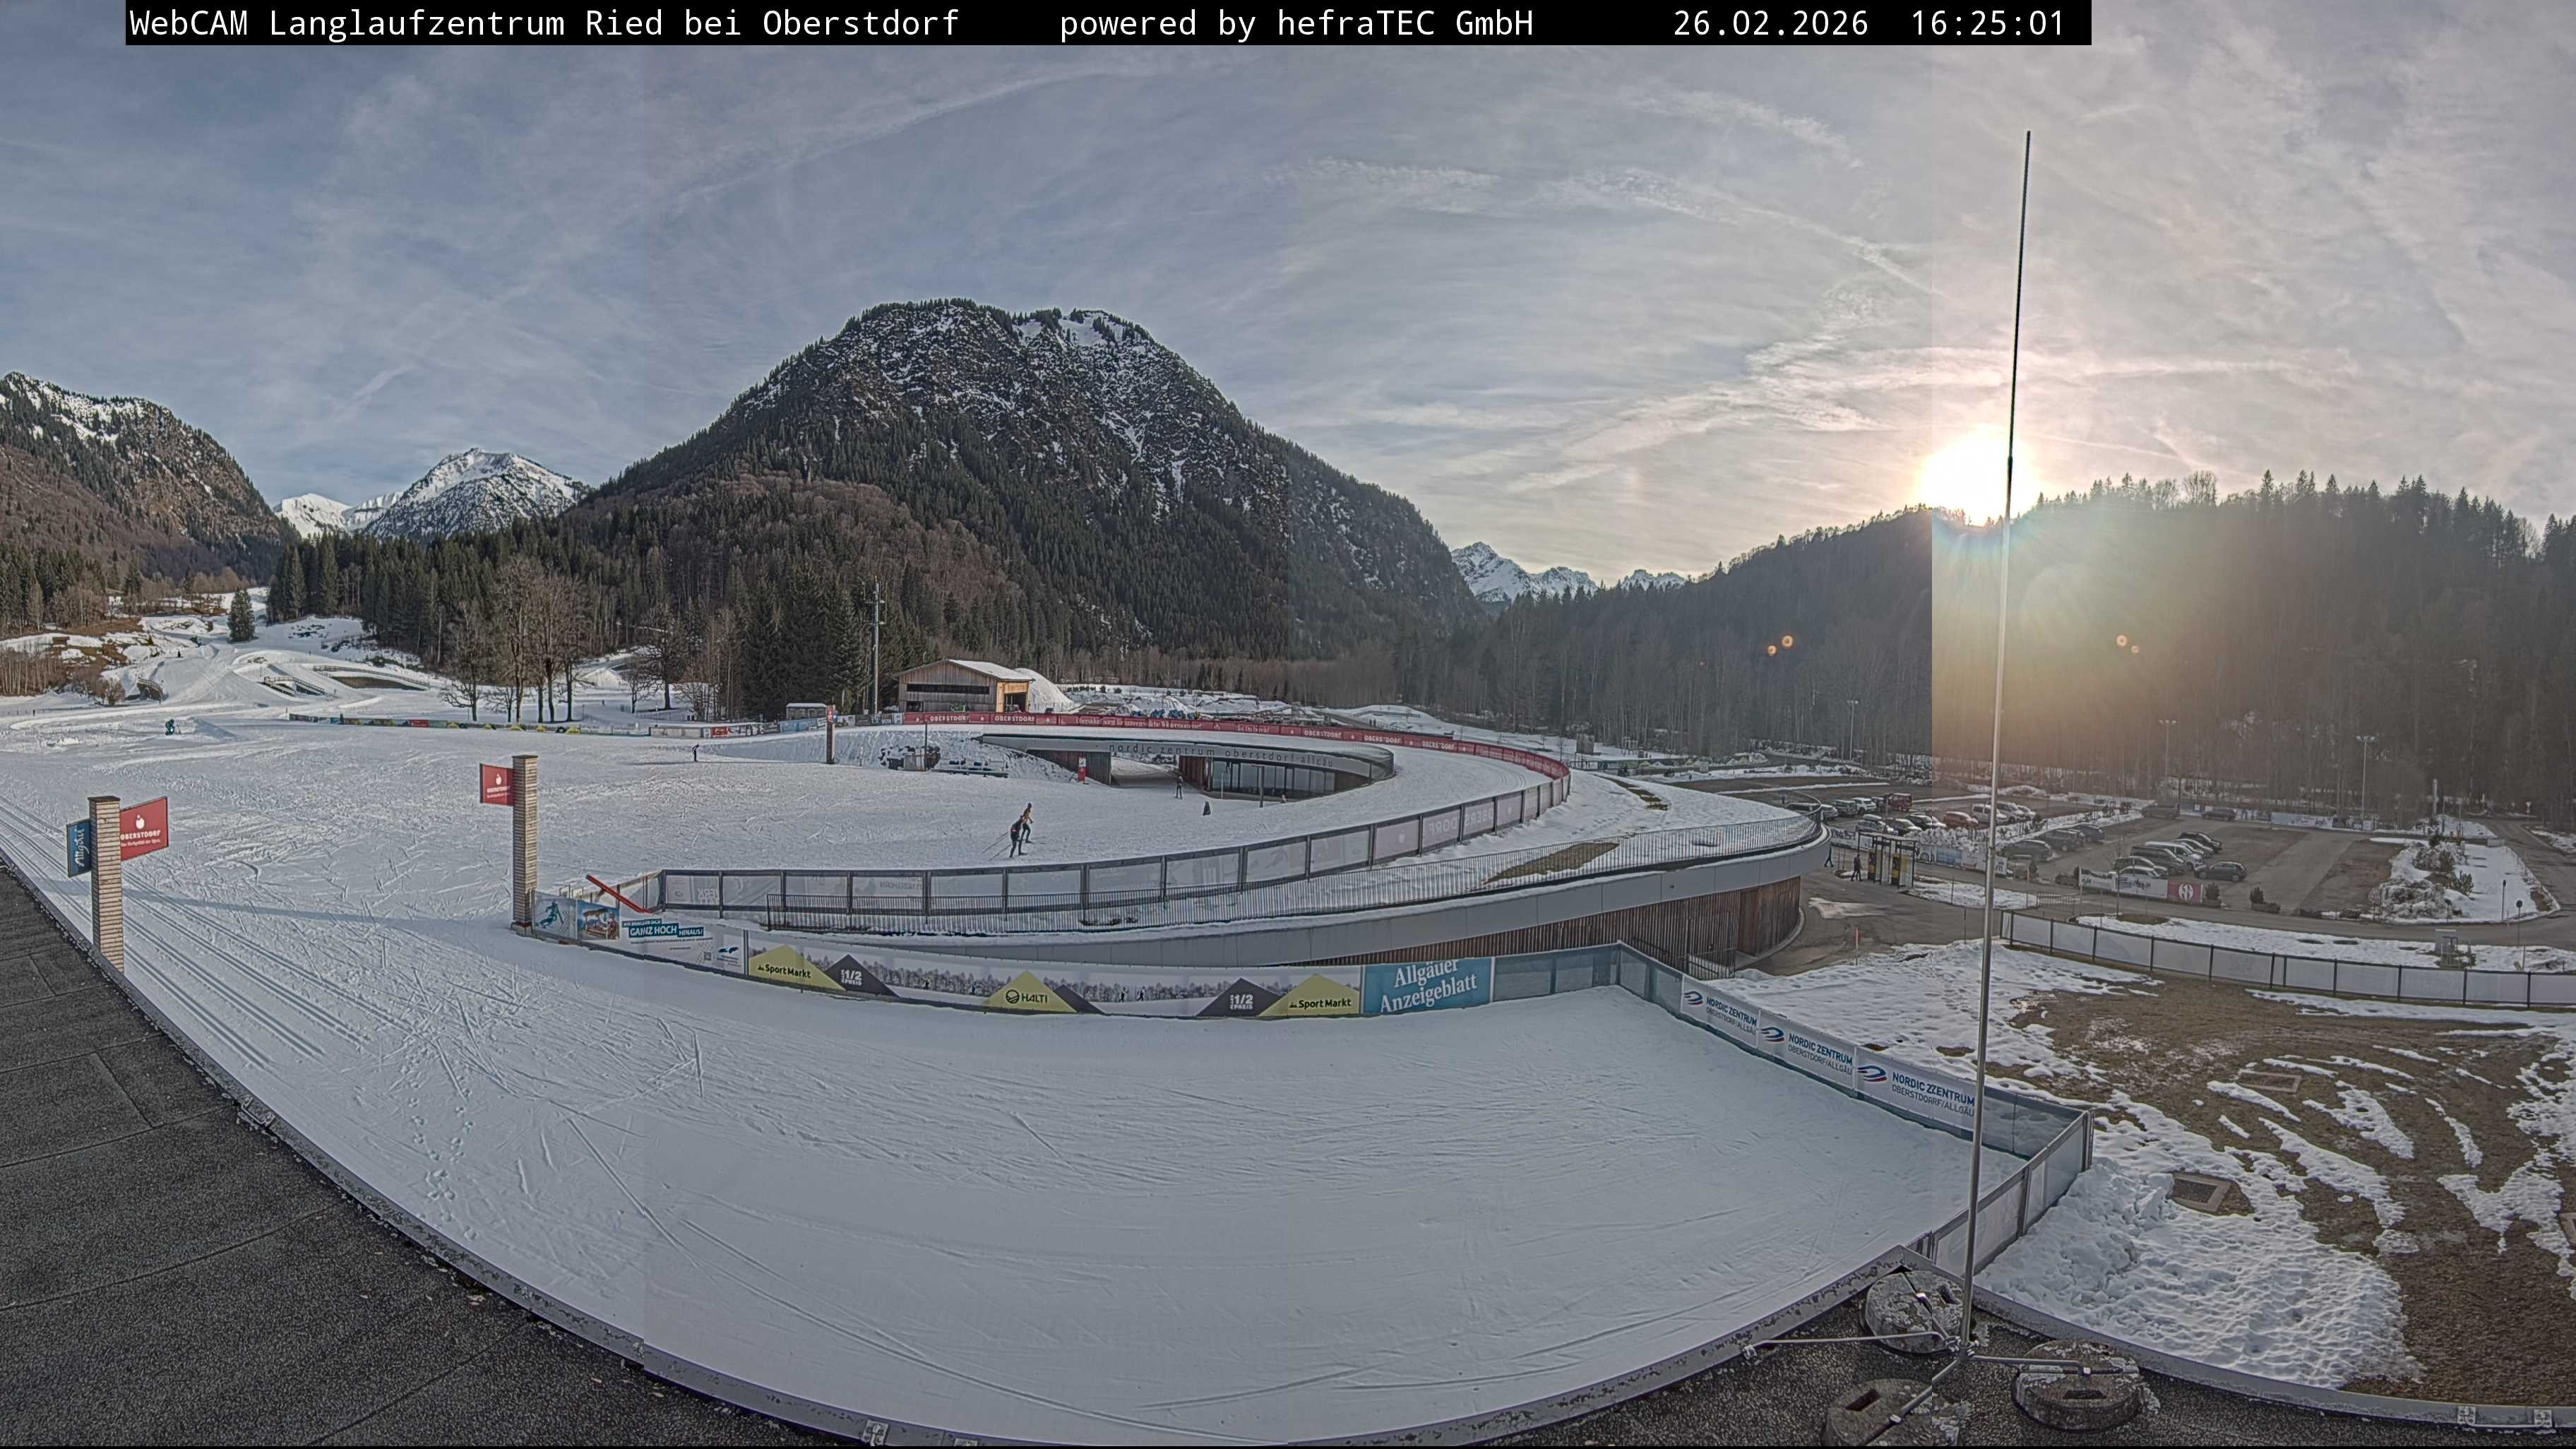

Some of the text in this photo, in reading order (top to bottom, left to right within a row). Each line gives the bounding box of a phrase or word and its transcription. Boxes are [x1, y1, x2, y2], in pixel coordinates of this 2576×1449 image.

[1304, 730, 1342, 739] OBERSTDORF
[1109, 744, 1152, 753] nordic
[1160, 746, 1215, 756] zentrum
[120, 830, 161, 840] OBERSTDORF
[654, 925, 678, 935] HOCH
[845, 970, 861, 980] 1/2
[1394, 960, 1459, 988] Allgäuer
[1021, 994, 1048, 1003] HALTI
[1234, 994, 1253, 1004] 1/2
[1381, 974, 1478, 1013] Anzeigeblatt
[1707, 997, 1758, 1027] NORDIC ZENTRUM
[1789, 1034, 1853, 1066] NORDIC ZENTRUM
[1892, 1073, 1926, 1091] NORDIC
